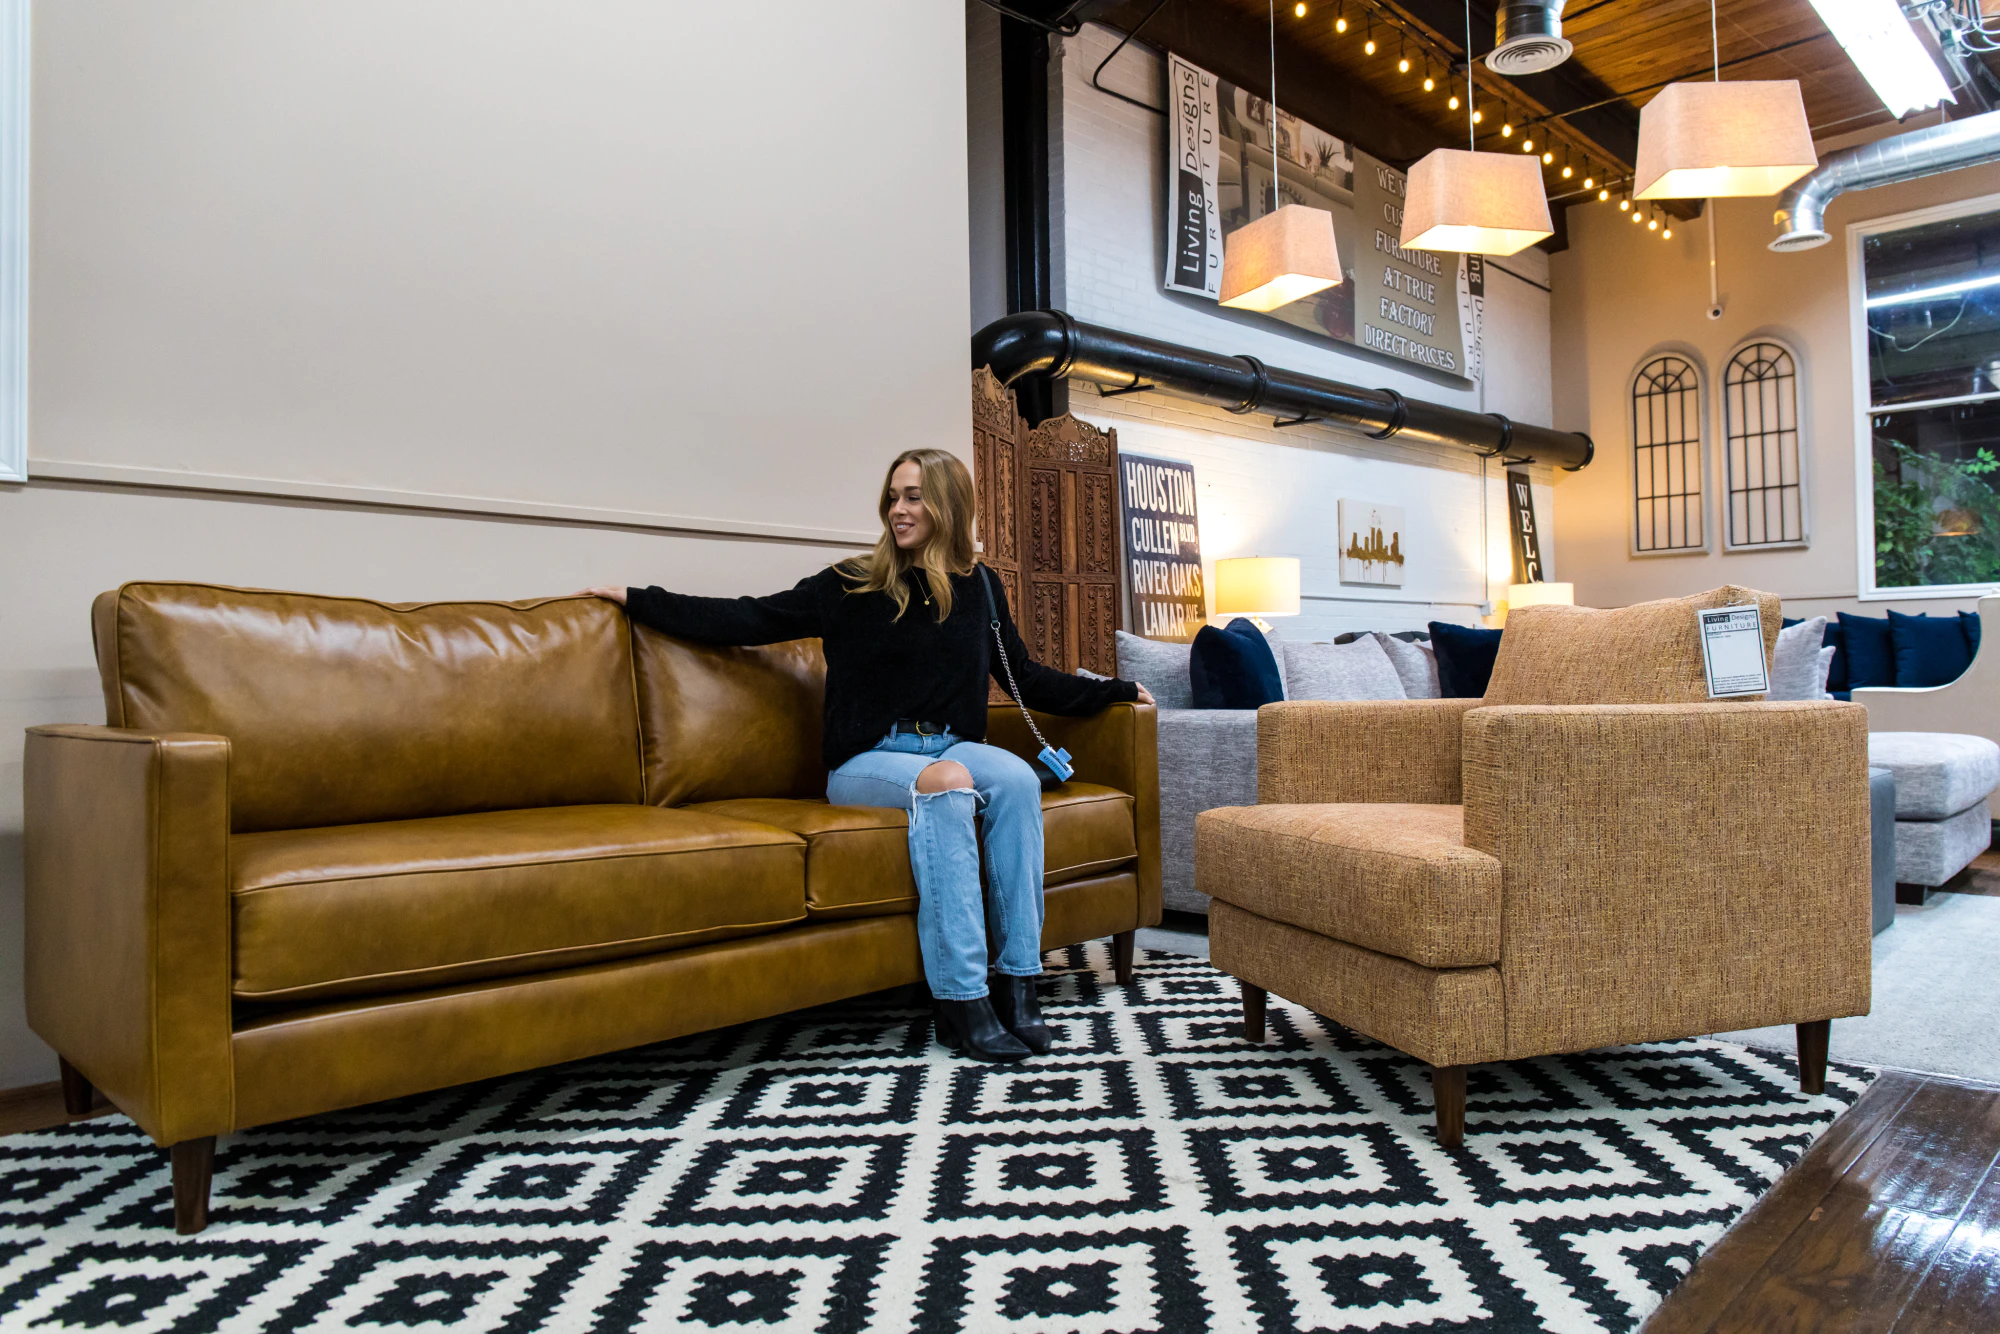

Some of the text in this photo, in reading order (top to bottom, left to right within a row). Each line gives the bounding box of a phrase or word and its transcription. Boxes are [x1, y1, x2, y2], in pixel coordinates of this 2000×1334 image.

[1182, 73, 1203, 273] Living Designs
[1201, 75, 1219, 293] FURNITURE
[1376, 167, 1396, 194] WE
[1383, 266, 1435, 304] AT TRUE
[1380, 297, 1436, 336] FACTORY
[1364, 323, 1455, 370] DIRECT PRICES
[1125, 461, 1195, 516] HOUSTON
[1131, 517, 1180, 555] CULLEN
[1133, 559, 1201, 597] RIVER OAKS
[1142, 602, 1200, 636] LAMAR AVE
[1706, 622, 1757, 631] FURNITURE
